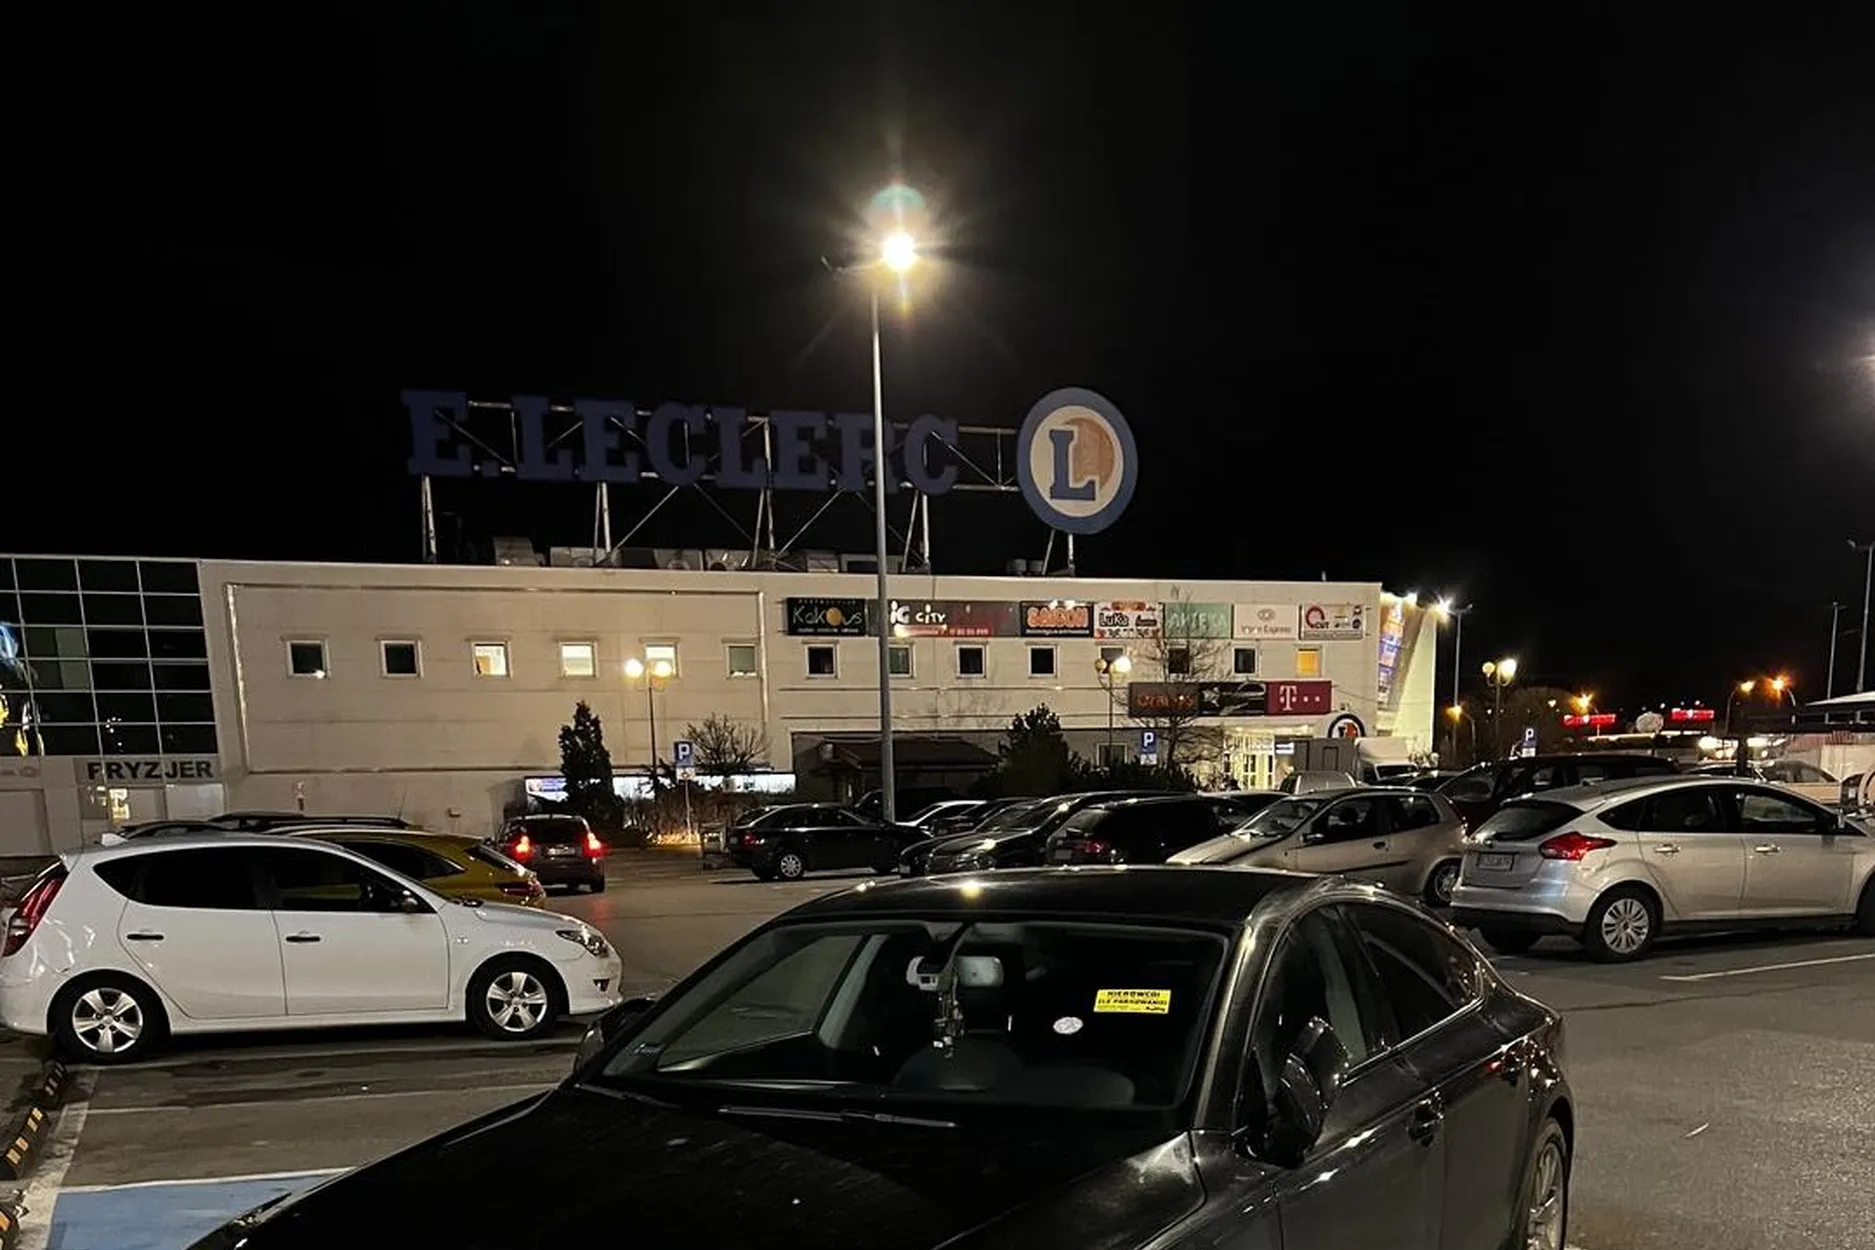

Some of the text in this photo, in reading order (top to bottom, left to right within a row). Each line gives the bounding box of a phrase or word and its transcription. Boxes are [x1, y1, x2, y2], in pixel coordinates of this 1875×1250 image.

[403, 390, 959, 495] E.LECLERC
[1049, 429, 1096, 501] L
[1144, 732, 1153, 744] P
[1525, 728, 1534, 740] P
[678, 743, 690, 759] P
[87, 761, 214, 780] FRYZJER
